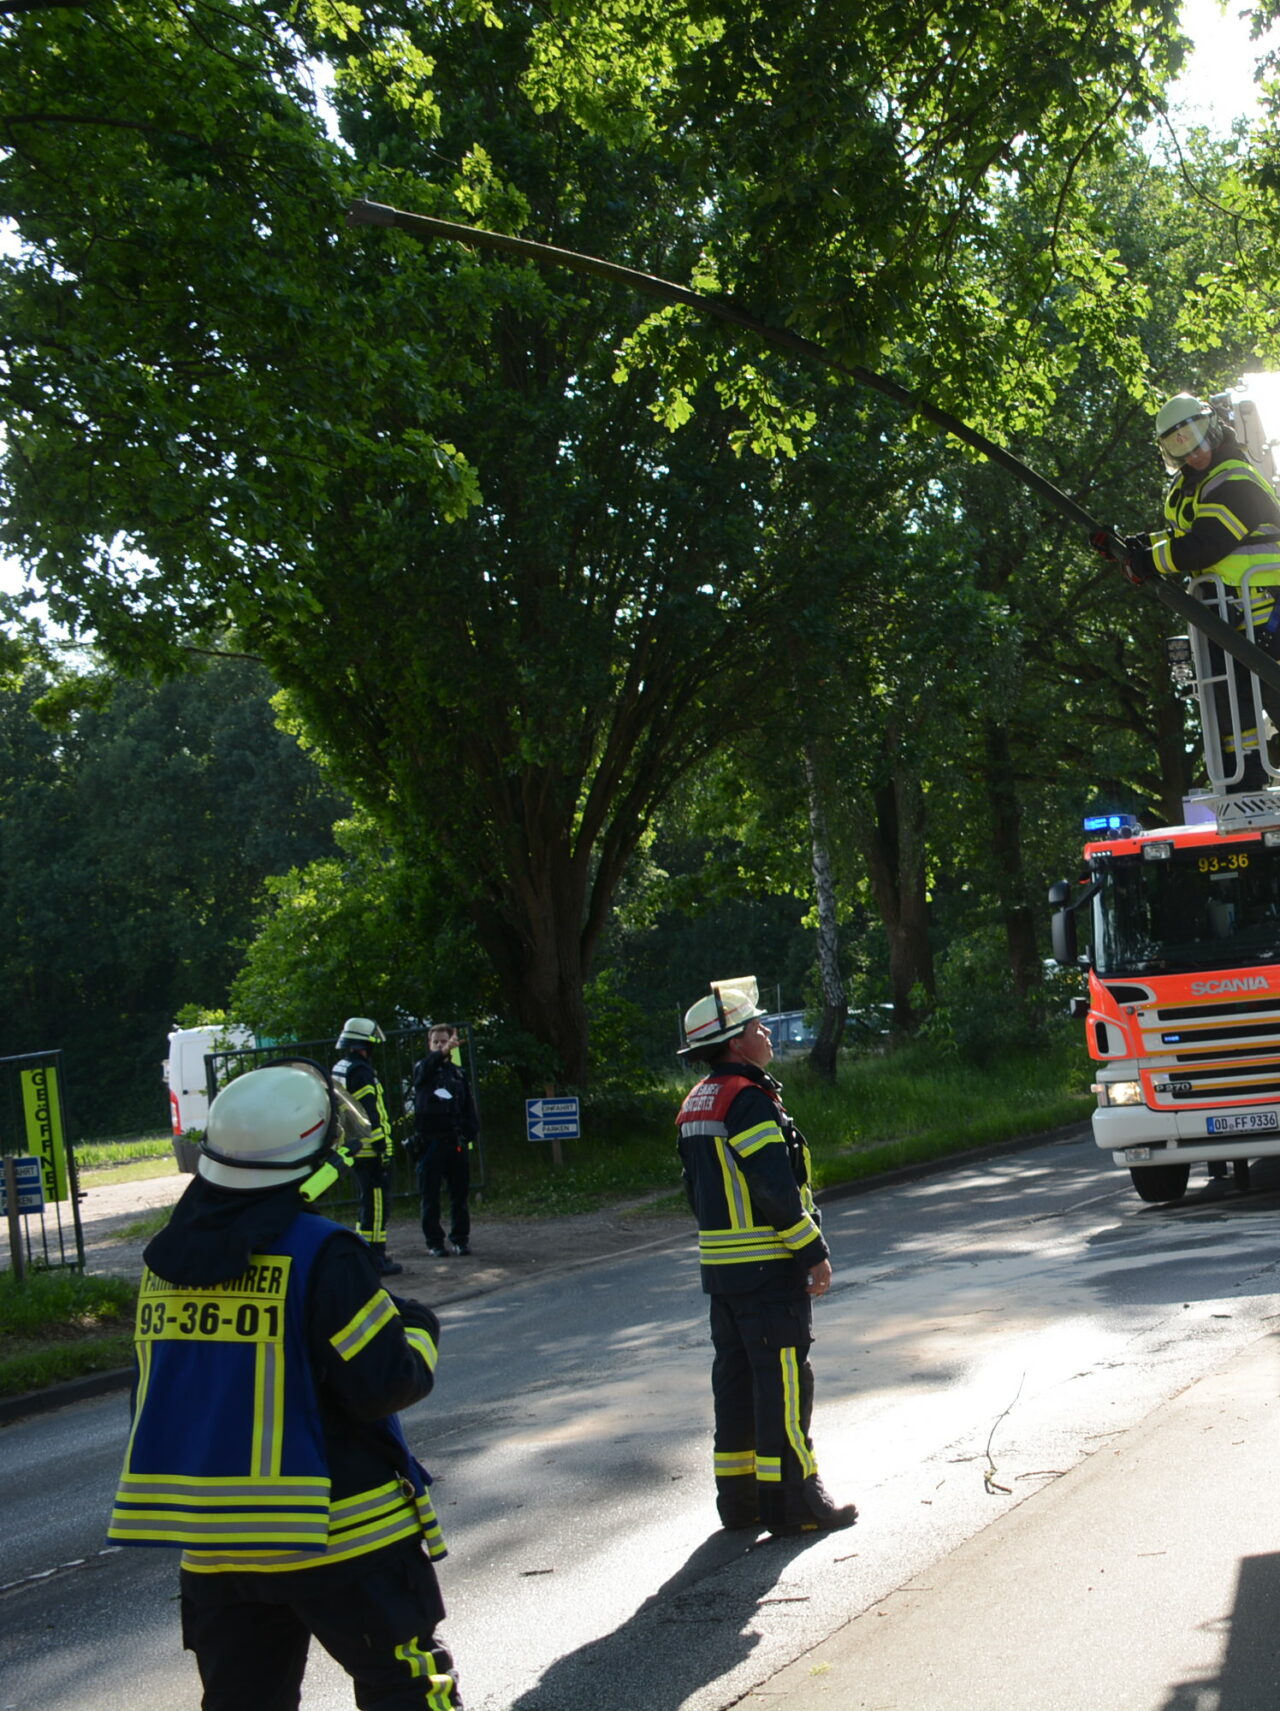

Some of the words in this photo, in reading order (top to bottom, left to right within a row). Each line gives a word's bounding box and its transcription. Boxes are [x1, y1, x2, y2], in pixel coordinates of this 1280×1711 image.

[1198, 853, 1249, 872] 93-36
[1190, 975, 1269, 996] SCANIA
[1165, 1083, 1190, 1092] 270
[1214, 1118, 1228, 1130] OD
[1235, 1116, 1248, 1128] FF
[1250, 1114, 1276, 1127] 9336
[31, 1072, 57, 1200] GEÖFFNET
[140, 1302, 278, 1337] 93-36-01
